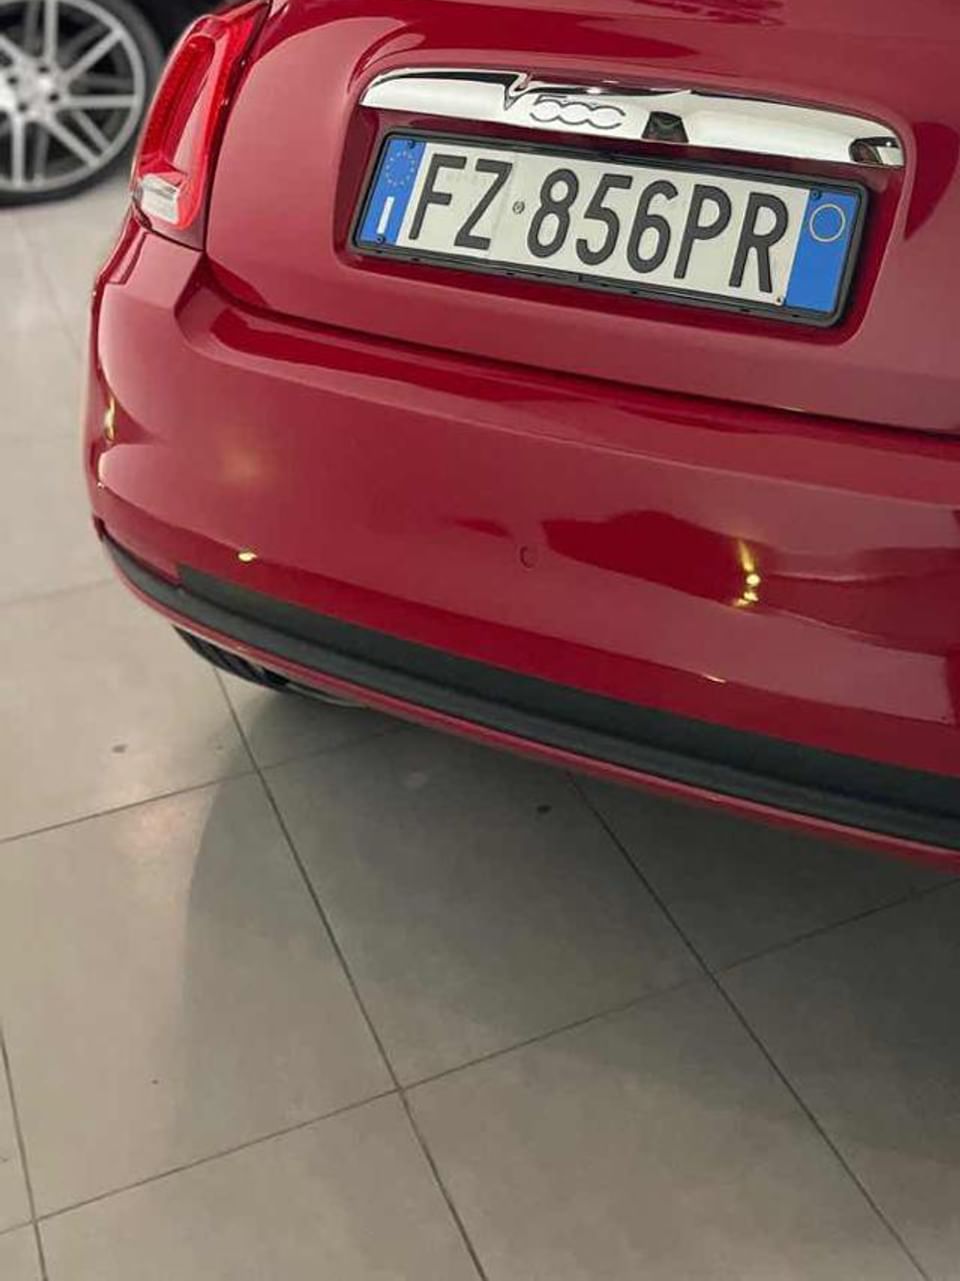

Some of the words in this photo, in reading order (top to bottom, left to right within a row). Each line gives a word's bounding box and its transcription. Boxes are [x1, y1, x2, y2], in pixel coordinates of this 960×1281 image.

[529, 95, 626, 130] 500
[408, 153, 513, 251] FZ
[527, 168, 789, 293] 856PR
